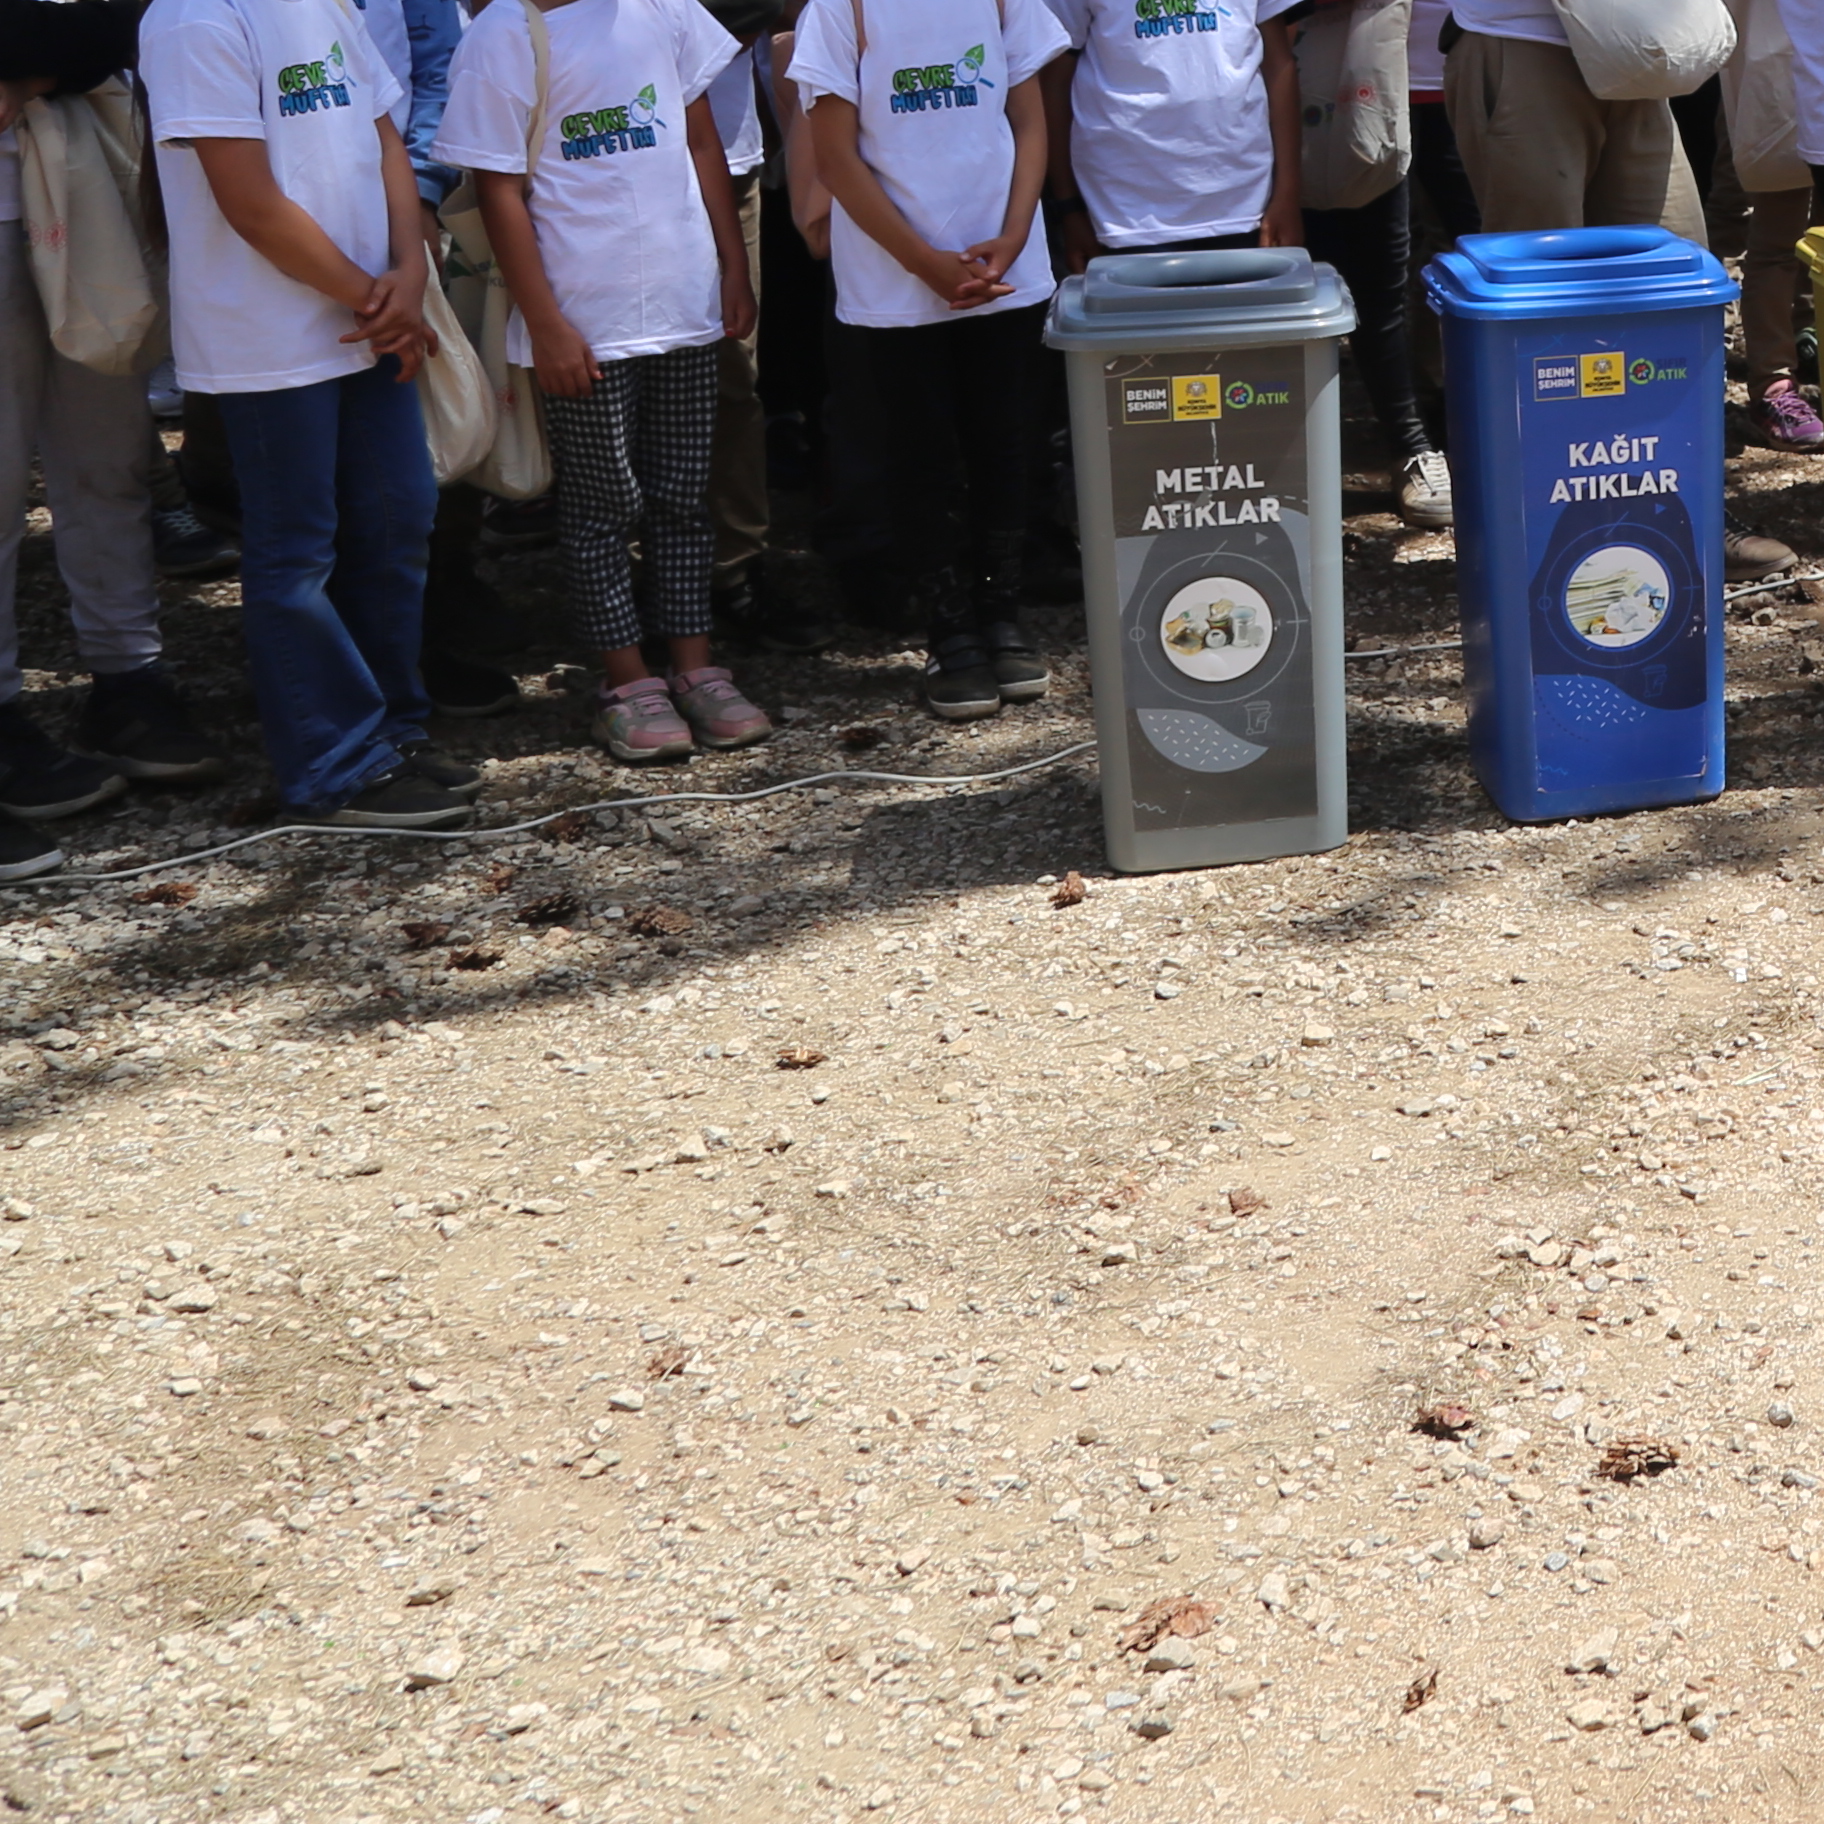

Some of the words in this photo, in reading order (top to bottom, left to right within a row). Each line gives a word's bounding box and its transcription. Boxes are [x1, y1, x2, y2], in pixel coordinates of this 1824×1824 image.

[1657, 367, 1687, 381] ATIK
[1256, 392, 1289, 406] ATIK
[1569, 434, 1659, 467] KAĞIT
[1156, 464, 1265, 495] METAL
[1550, 468, 1679, 504] ATIKLAR
[1141, 497, 1282, 531] ATIKLAR
